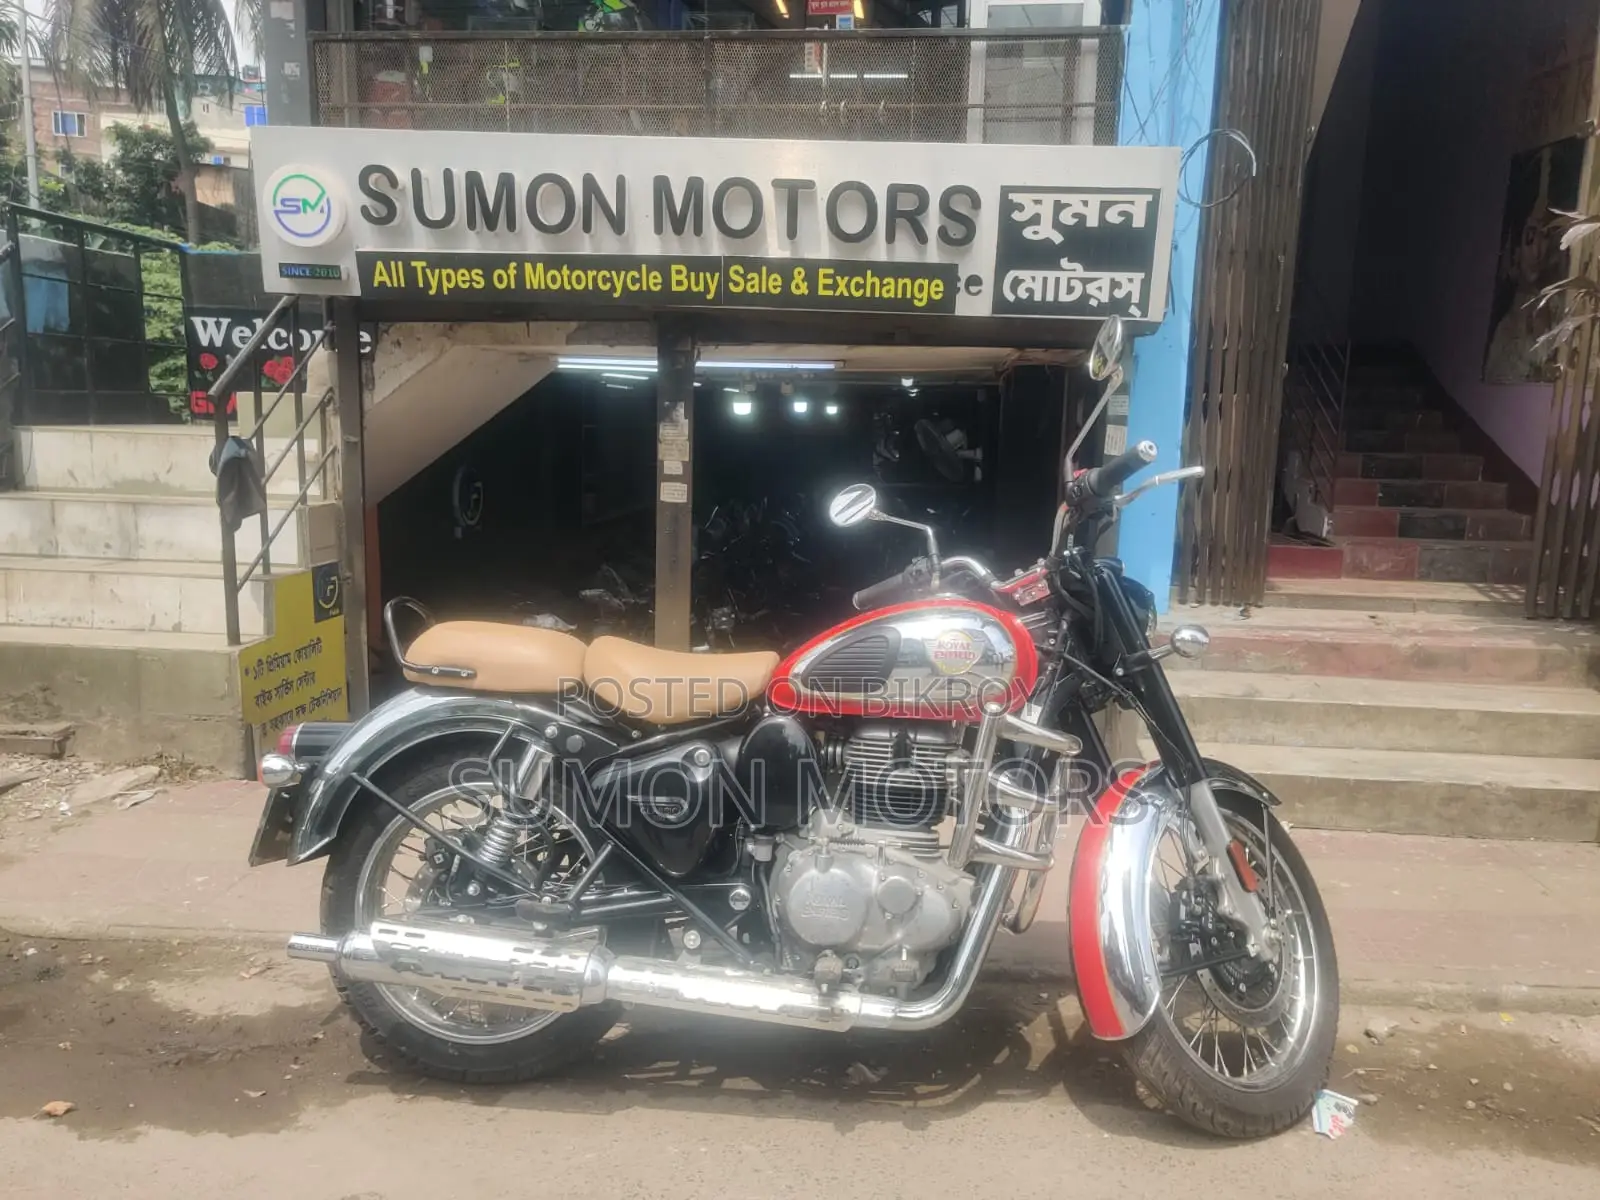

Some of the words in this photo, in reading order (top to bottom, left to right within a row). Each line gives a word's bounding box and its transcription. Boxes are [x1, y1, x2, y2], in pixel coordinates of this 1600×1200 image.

[358, 164, 626, 236] SUMON
[653, 175, 982, 247] MOTORS
[1008, 192, 1153, 245] সুমন
[281, 265, 311, 277] SINCE
[373, 261, 405, 288] All
[411, 261, 485, 295] Types
[493, 262, 517, 289] of
[524, 263, 662, 298] Motorcycle
[670, 264, 720, 299] Buy
[728, 265, 783, 294] Sale
[790, 267, 809, 295] &
[818, 268, 944, 307] Exchange
[1002, 257, 1146, 317] মোটরস্
